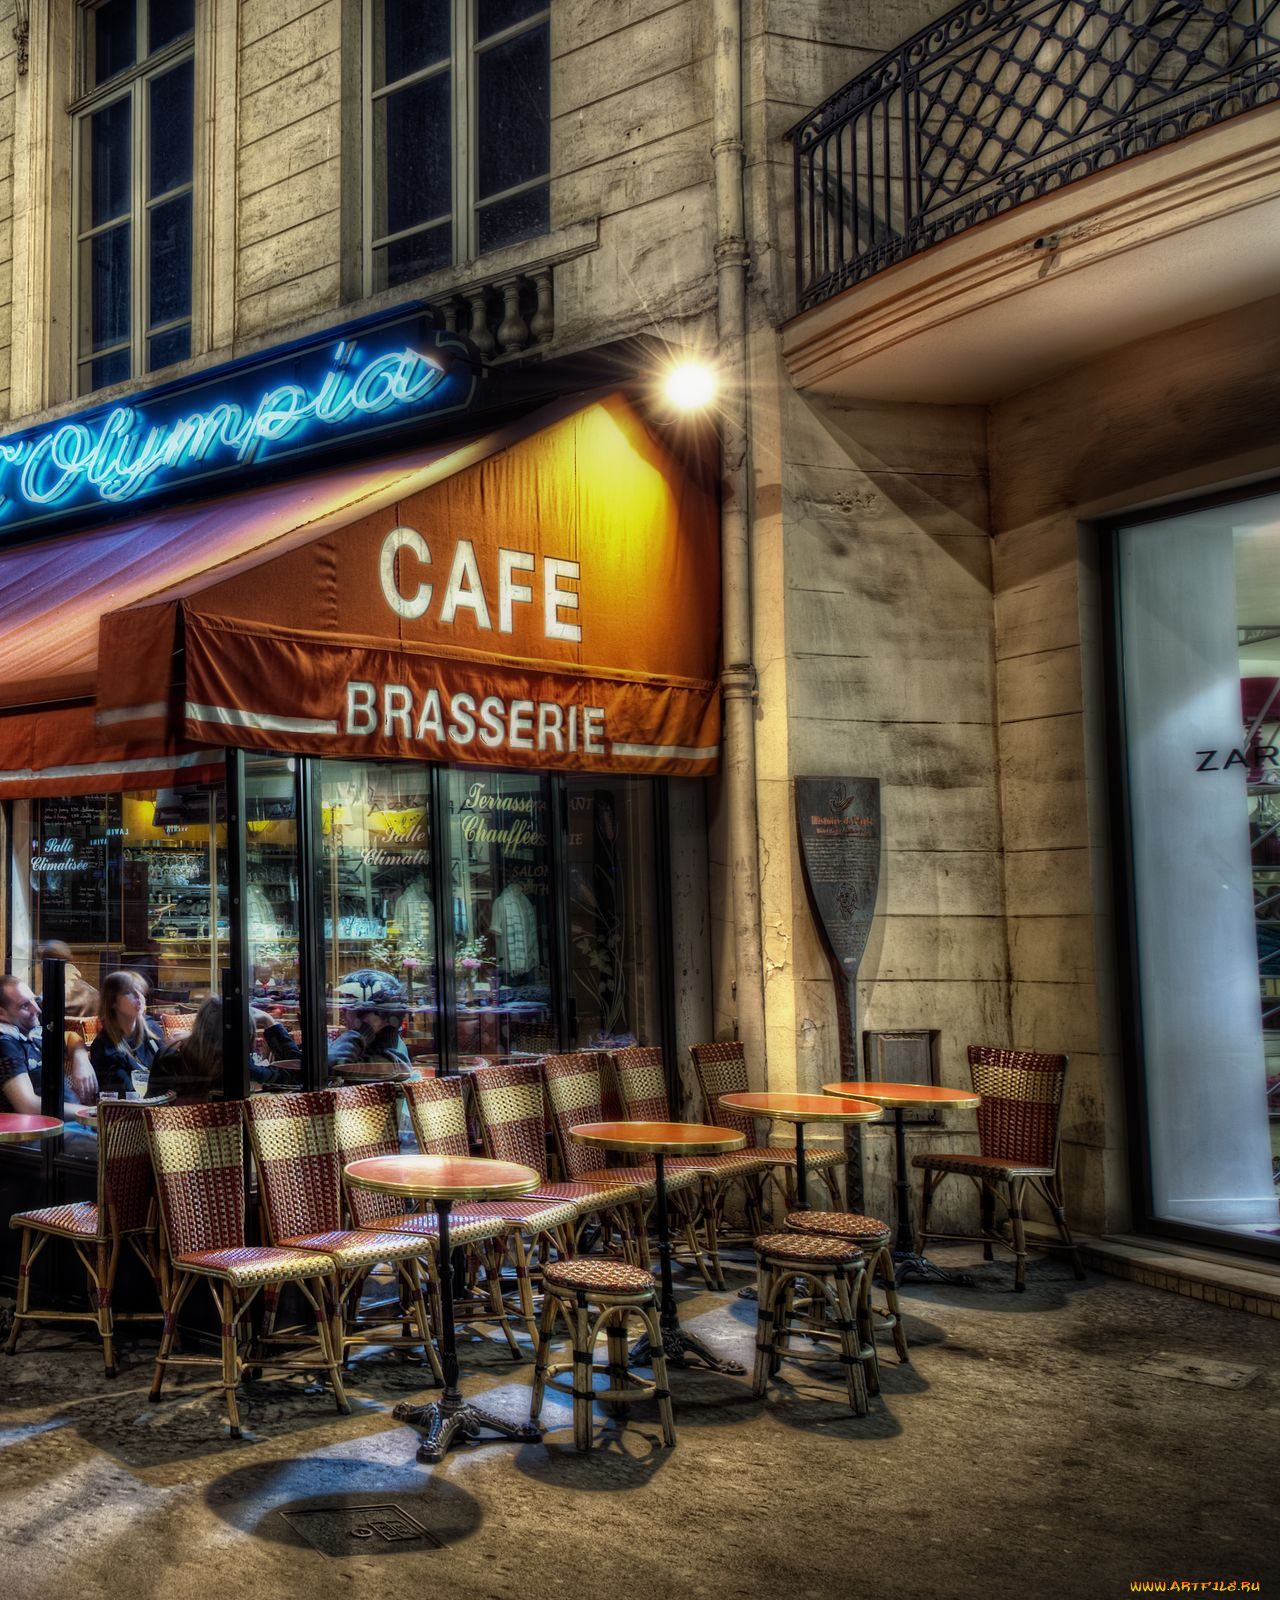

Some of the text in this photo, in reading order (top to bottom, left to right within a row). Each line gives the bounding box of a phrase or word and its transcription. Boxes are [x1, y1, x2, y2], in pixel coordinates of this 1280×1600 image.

[378, 525, 583, 644] CAFE
[345, 681, 606, 755] BRASSERIE
[1195, 745, 1280, 772] ZAR
[465, 782, 533, 812] Terrasse
[44, 838, 74, 853] Salle
[461, 816, 539, 855] Chauffée
